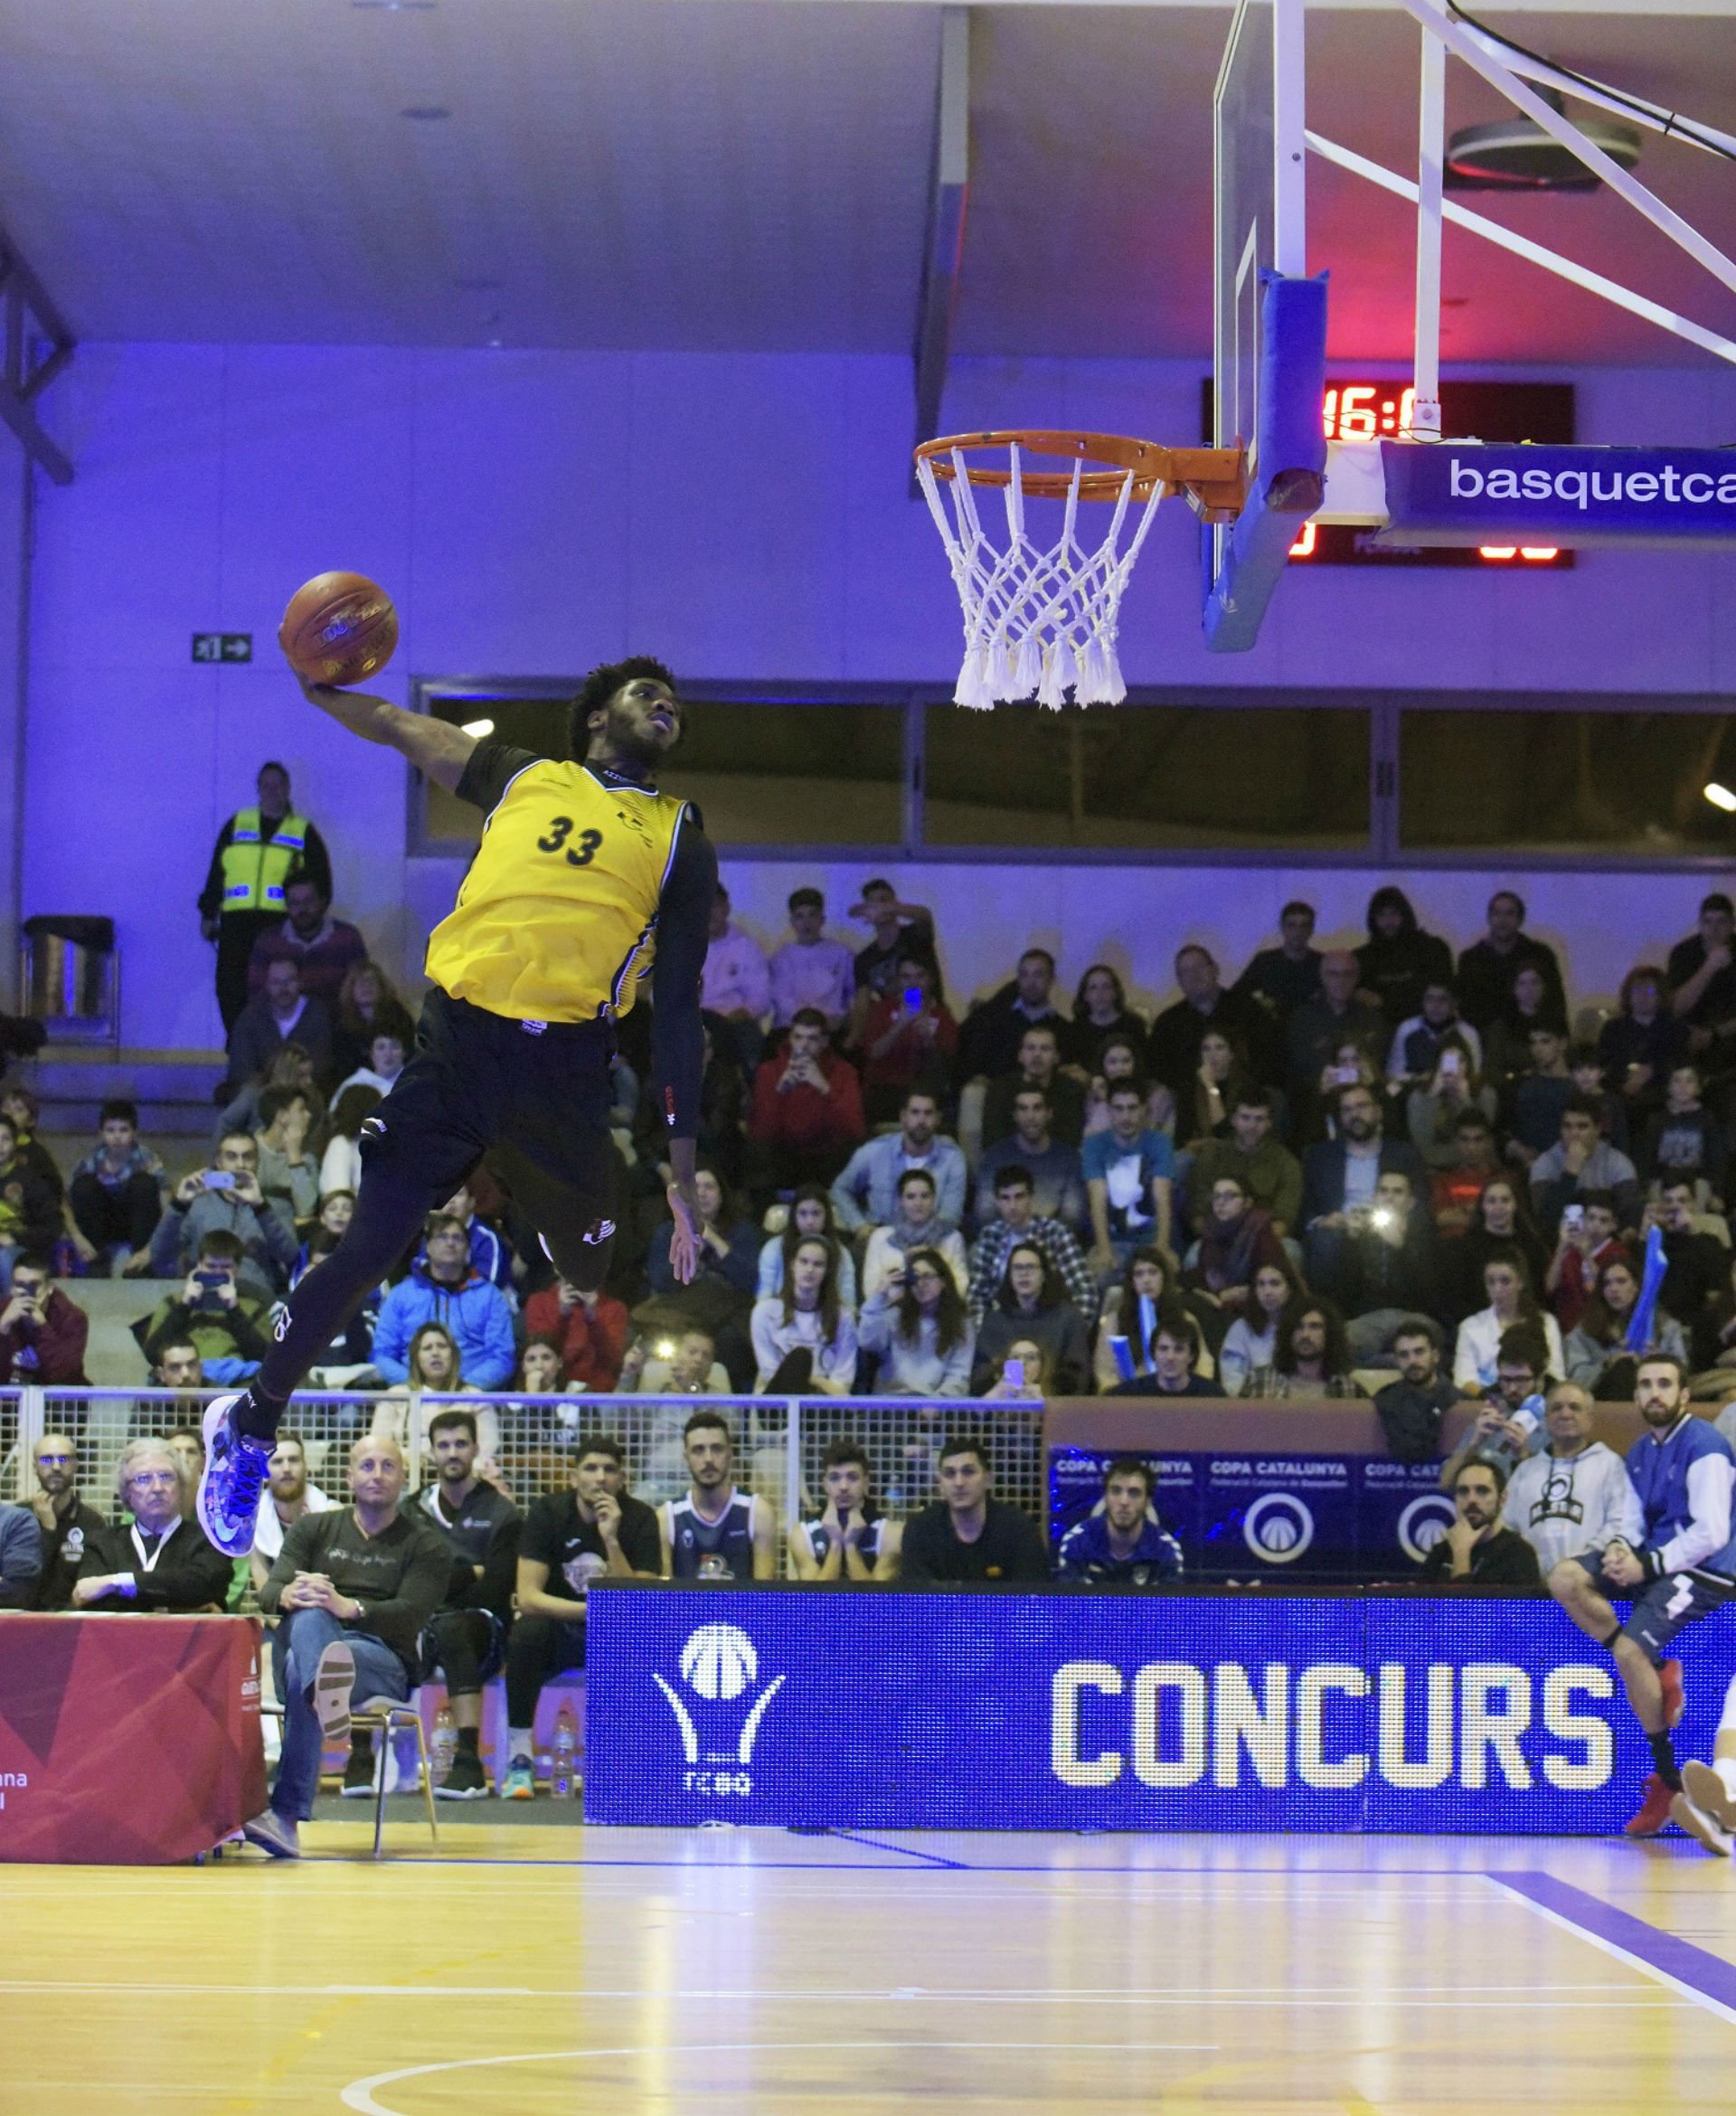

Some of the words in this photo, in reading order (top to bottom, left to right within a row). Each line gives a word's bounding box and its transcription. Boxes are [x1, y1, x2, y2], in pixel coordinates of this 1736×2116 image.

[537, 816, 603, 866] 33
[1056, 1459, 1098, 1473] COPA
[1210, 1460, 1252, 1475] COPA
[1256, 1461, 1348, 1476] CATALUNYA
[1364, 1463, 1406, 1477] COPA
[1051, 1661, 1614, 1790] CONCURS
